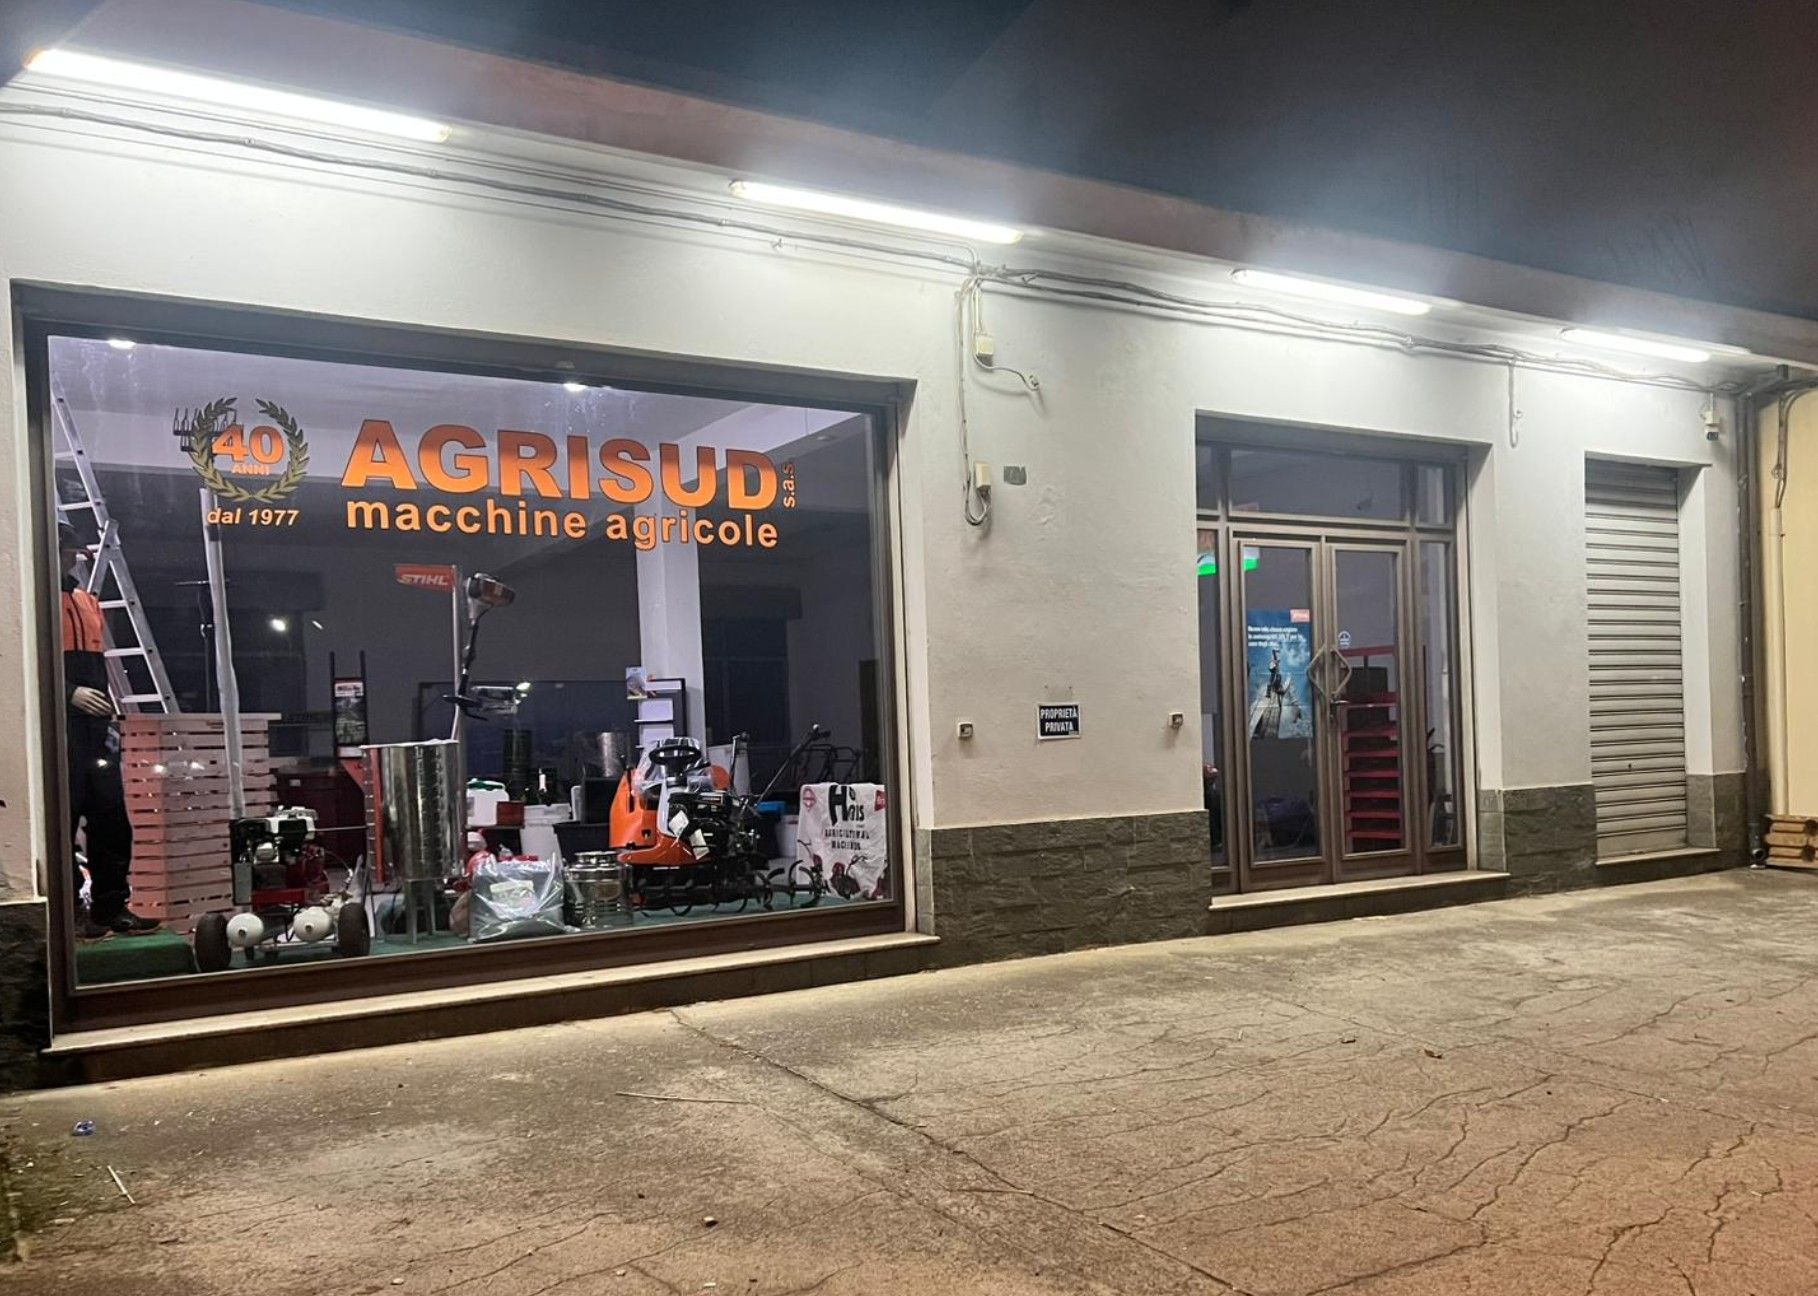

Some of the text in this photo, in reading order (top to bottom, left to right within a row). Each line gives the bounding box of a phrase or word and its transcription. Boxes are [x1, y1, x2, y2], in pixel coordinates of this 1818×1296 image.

[211, 424, 284, 465] 40
[231, 464, 271, 476] ANNI
[341, 419, 778, 511] AGRISUD
[207, 507, 300, 527] dal 1977
[346, 499, 778, 550] macchine agricole
[396, 573, 449, 586] STIHL
[1045, 721, 1074, 732] PRIVATA
